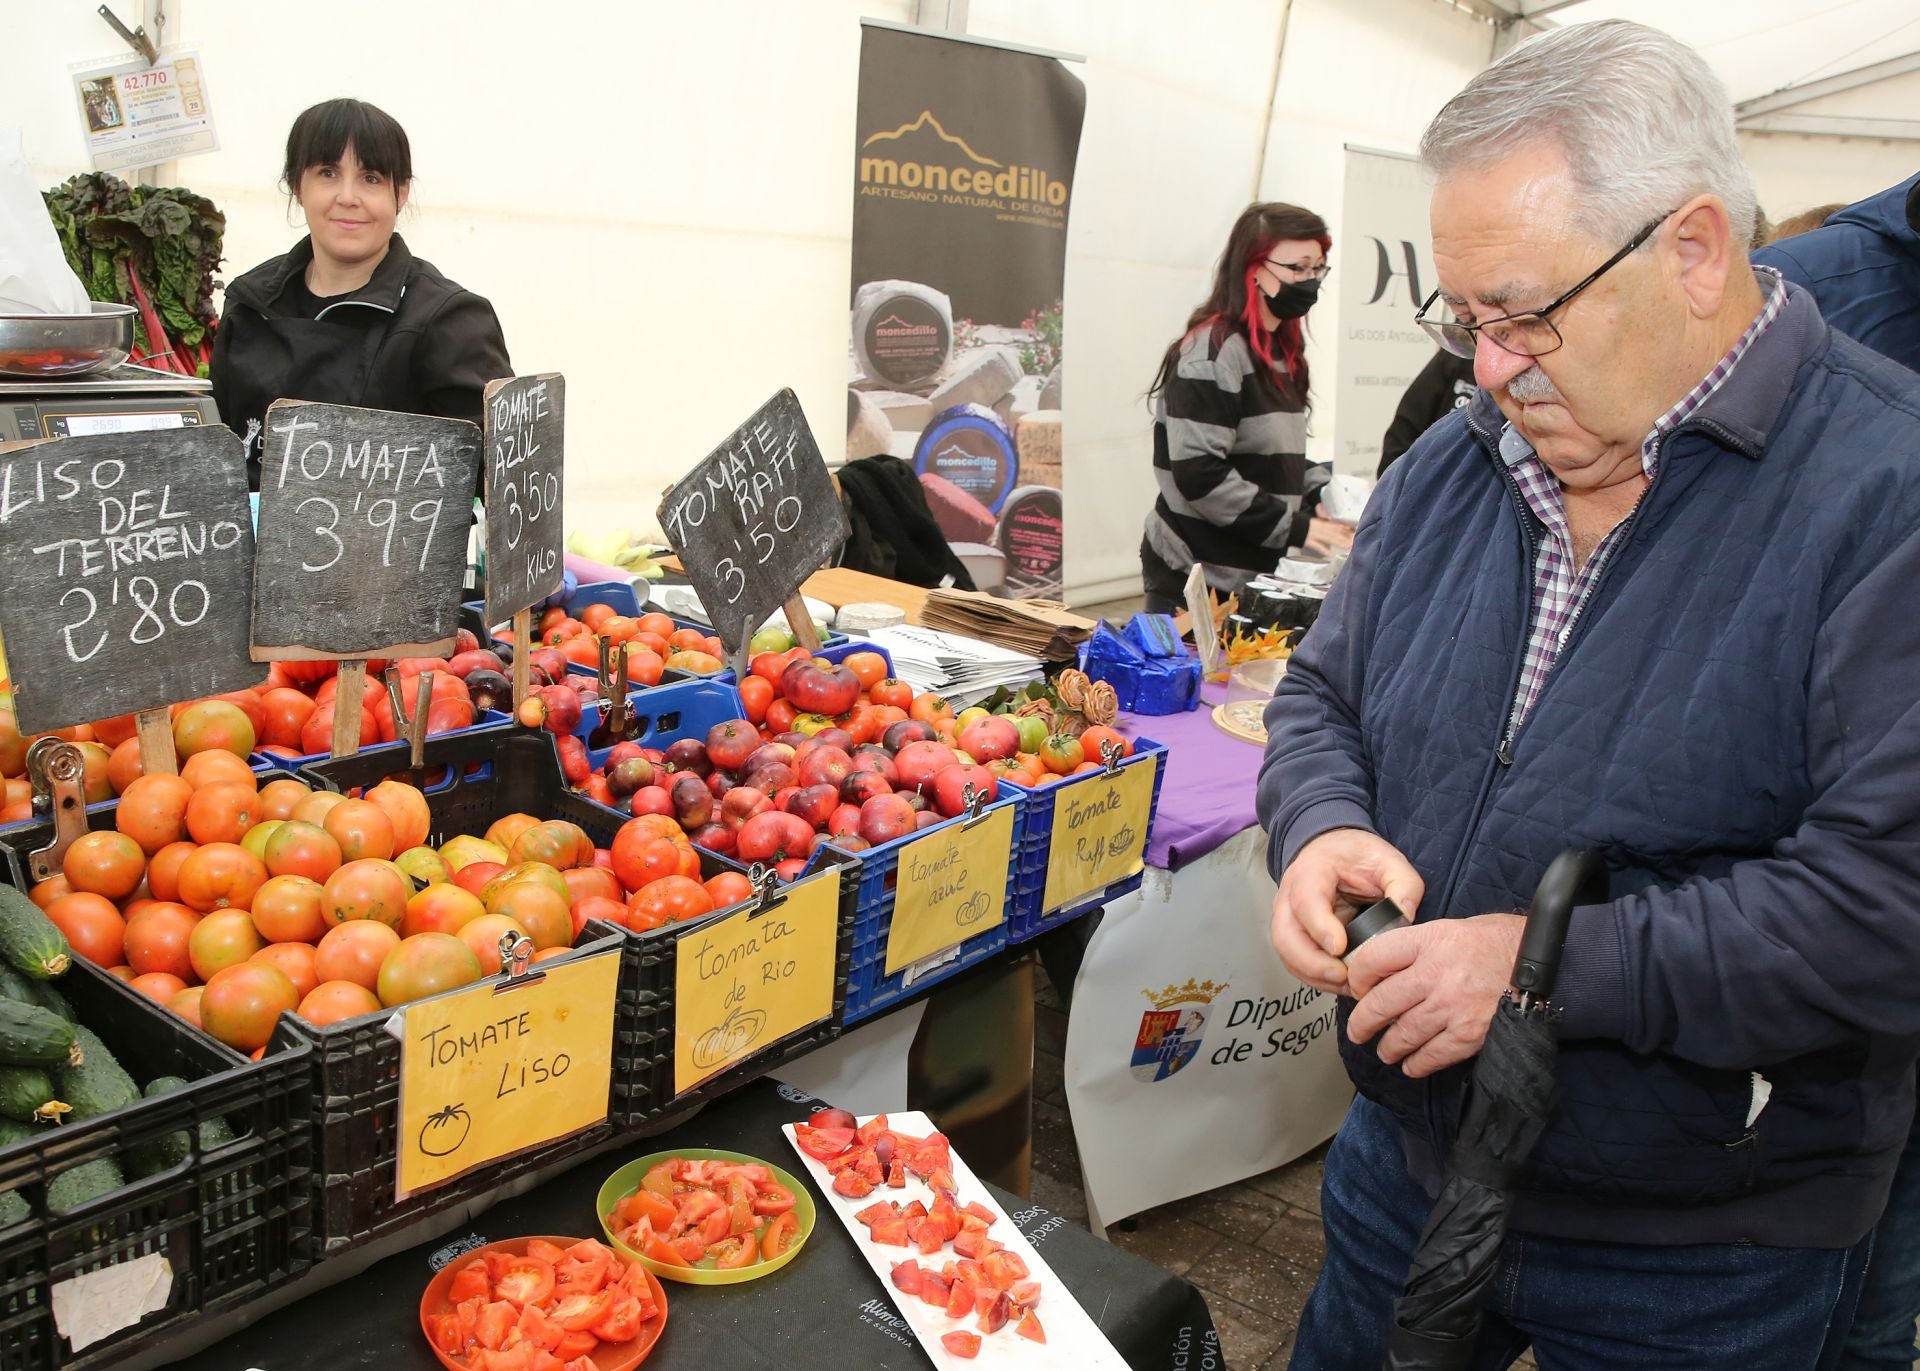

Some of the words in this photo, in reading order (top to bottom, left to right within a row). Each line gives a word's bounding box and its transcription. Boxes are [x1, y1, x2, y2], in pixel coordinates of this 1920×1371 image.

[124, 71, 167, 90] 42.770
[860, 157, 1067, 206] moncedillo
[860, 186, 938, 203] ARTESANO
[942, 194, 1006, 210] NATURAL
[1010, 200, 1029, 212] DE
[876, 325, 937, 337] moncedillo
[491, 382, 550, 437] TOMATE
[272, 415, 446, 492] TOMATA
[493, 424, 541, 491] AZUL
[733, 429, 798, 525] RAFF
[936, 456, 997, 467] moncedillo
[0, 459, 126, 523] LISO
[99, 484, 192, 534] DEL
[503, 470, 558, 550] 3'50
[668, 420, 779, 548] TOMATE
[32, 521, 244, 577] TERRENO
[295, 491, 445, 572] 3'99
[715, 495, 802, 604] 3'50
[59, 576, 211, 662] 2'80
[1065, 784, 1122, 830] tomate
[908, 842, 963, 883] tomate
[1075, 836, 1105, 875] Raff
[928, 869, 968, 908] azul
[694, 920, 796, 981] tomata
[724, 977, 746, 1009] de
[421, 1011, 532, 1069] TOMATE
[1210, 1038, 1253, 1065] de
[1261, 1000, 1338, 1058] Segovi
[1172, 1326, 1192, 1371] ción
